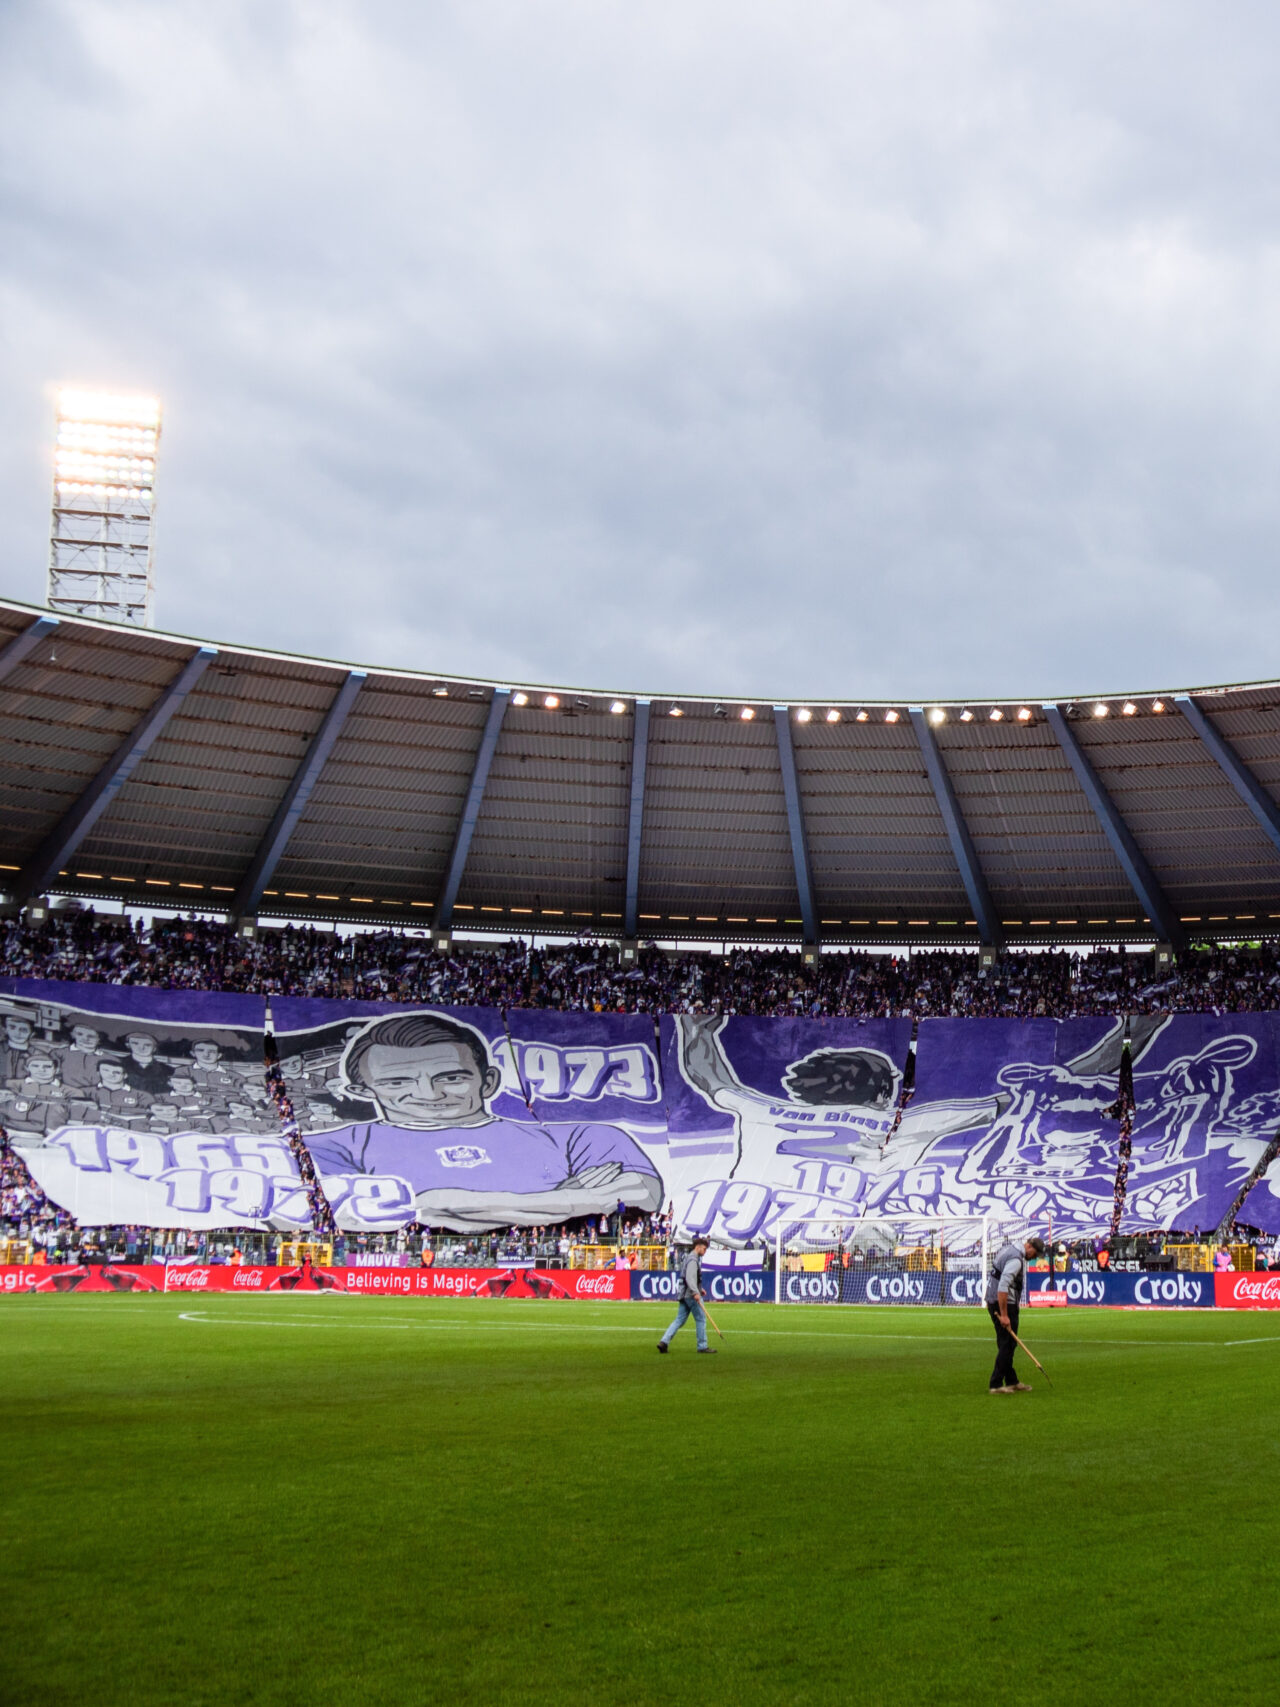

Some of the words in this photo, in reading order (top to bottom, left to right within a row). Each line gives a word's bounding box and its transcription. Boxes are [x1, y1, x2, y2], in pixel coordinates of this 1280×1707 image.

[492, 1038, 656, 1099] 1973
[355, 1254, 400, 1267] MAUVE
[347, 1272, 410, 1291] Believing
[416, 1273, 428, 1288] is
[433, 1274, 477, 1292] Magic
[639, 1272, 680, 1298] Crok
[711, 1273, 763, 1299] Croky
[786, 1273, 839, 1300] Croky
[866, 1273, 923, 1301] Croky
[1134, 1274, 1201, 1303] Croky
